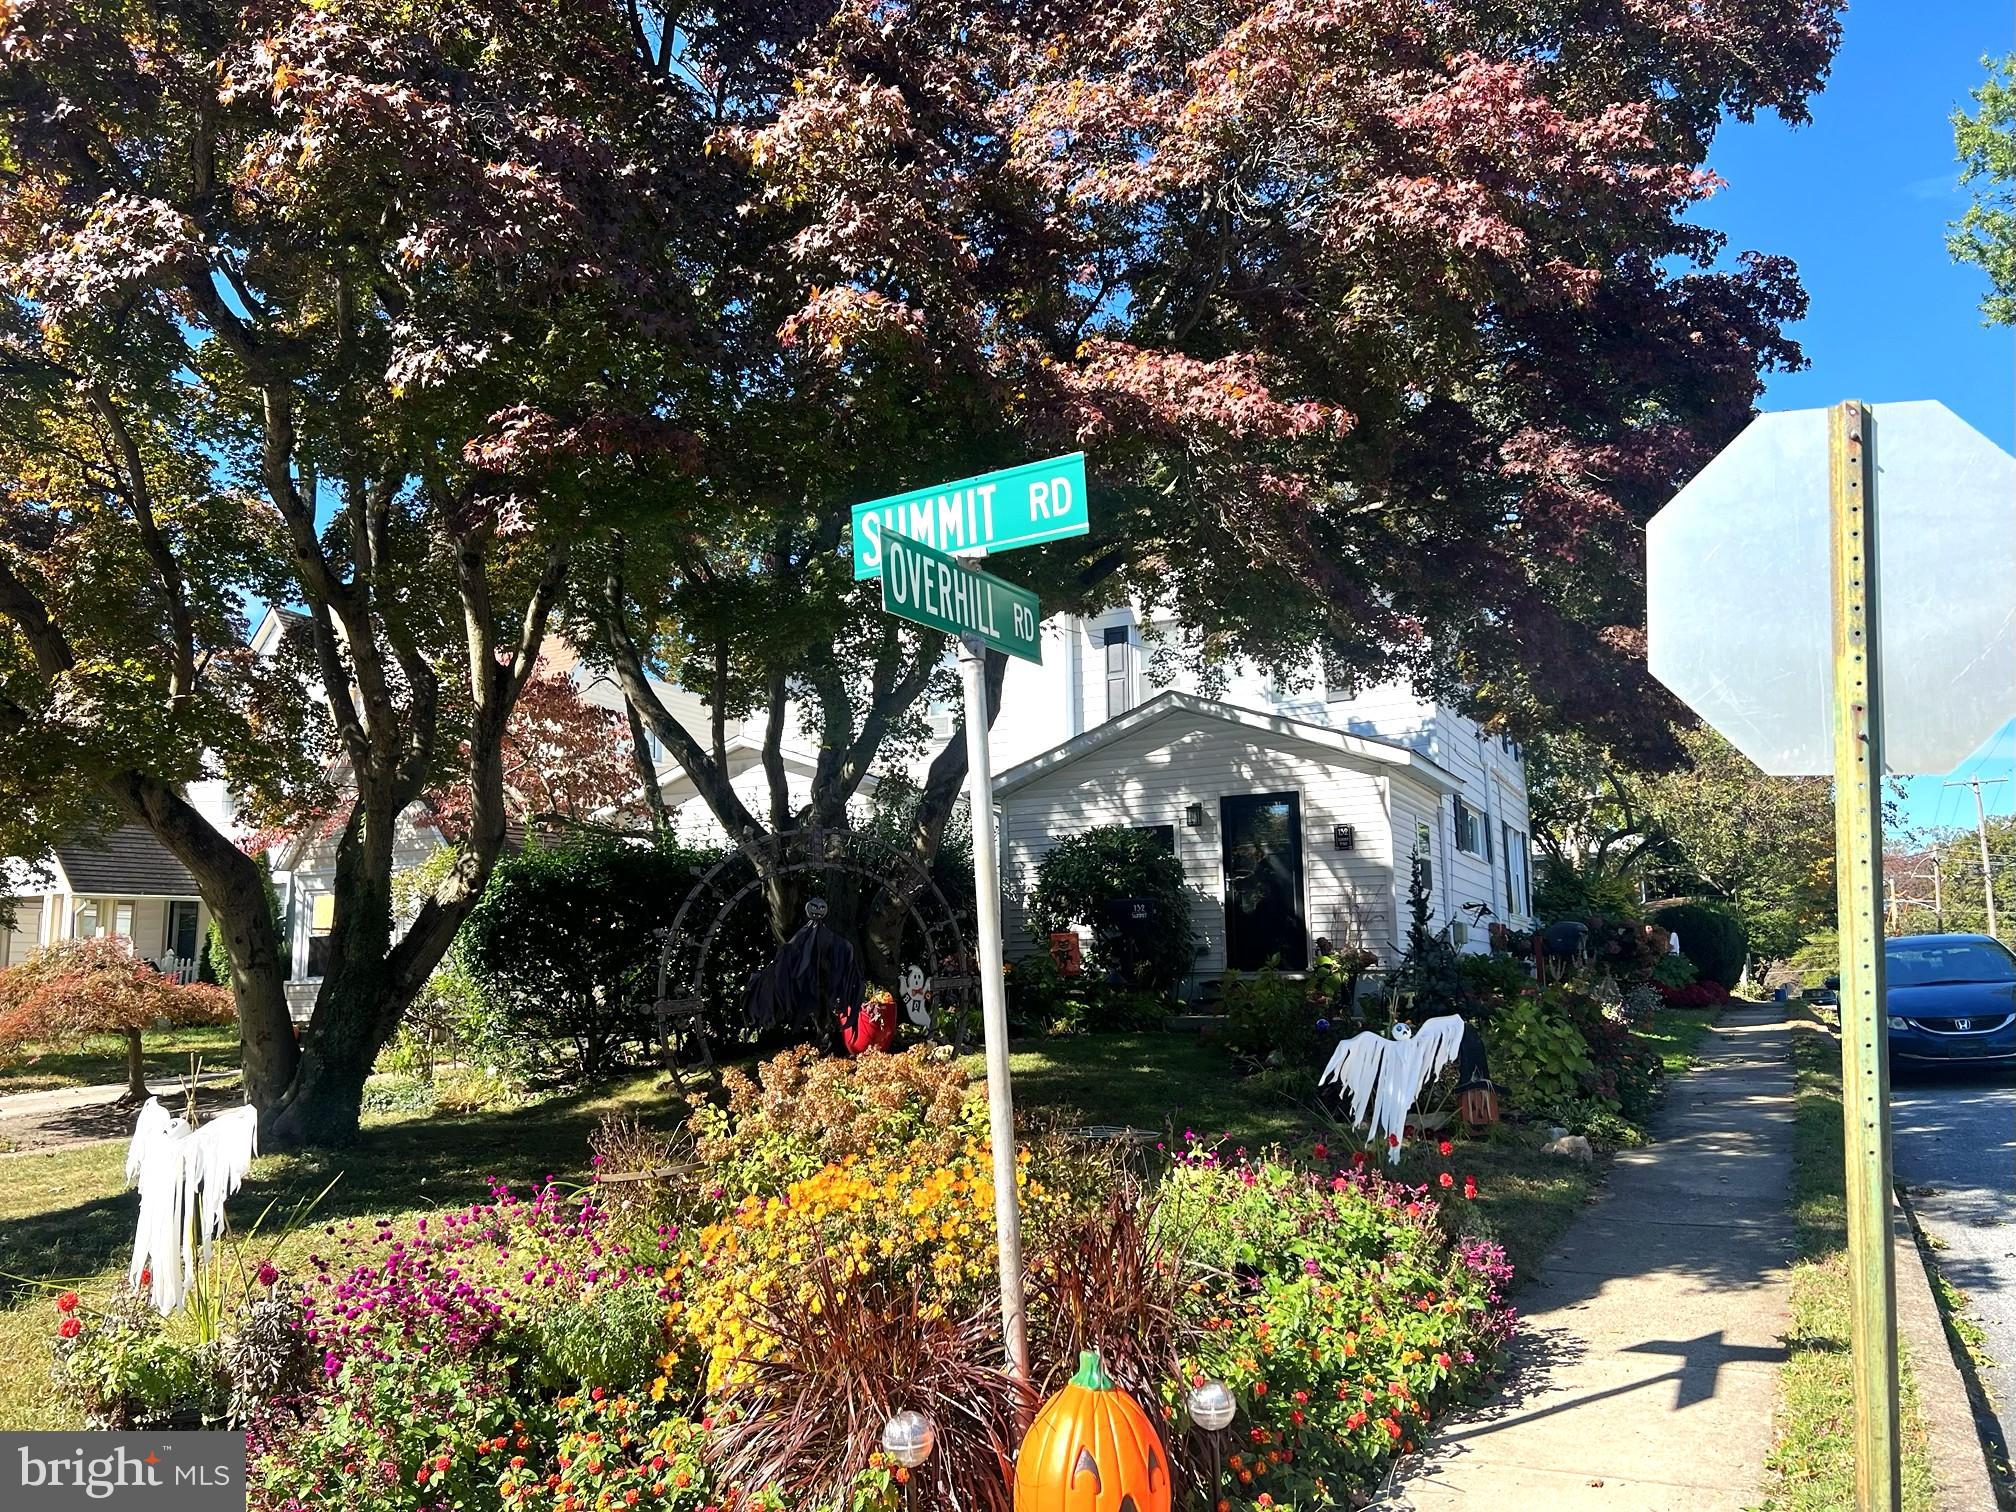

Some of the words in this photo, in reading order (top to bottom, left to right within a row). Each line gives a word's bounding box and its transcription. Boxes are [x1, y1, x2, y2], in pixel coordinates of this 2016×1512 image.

[1028, 476, 1073, 522] RD
[889, 542, 1001, 639] OVERHILL
[1012, 601, 1035, 643] RD
